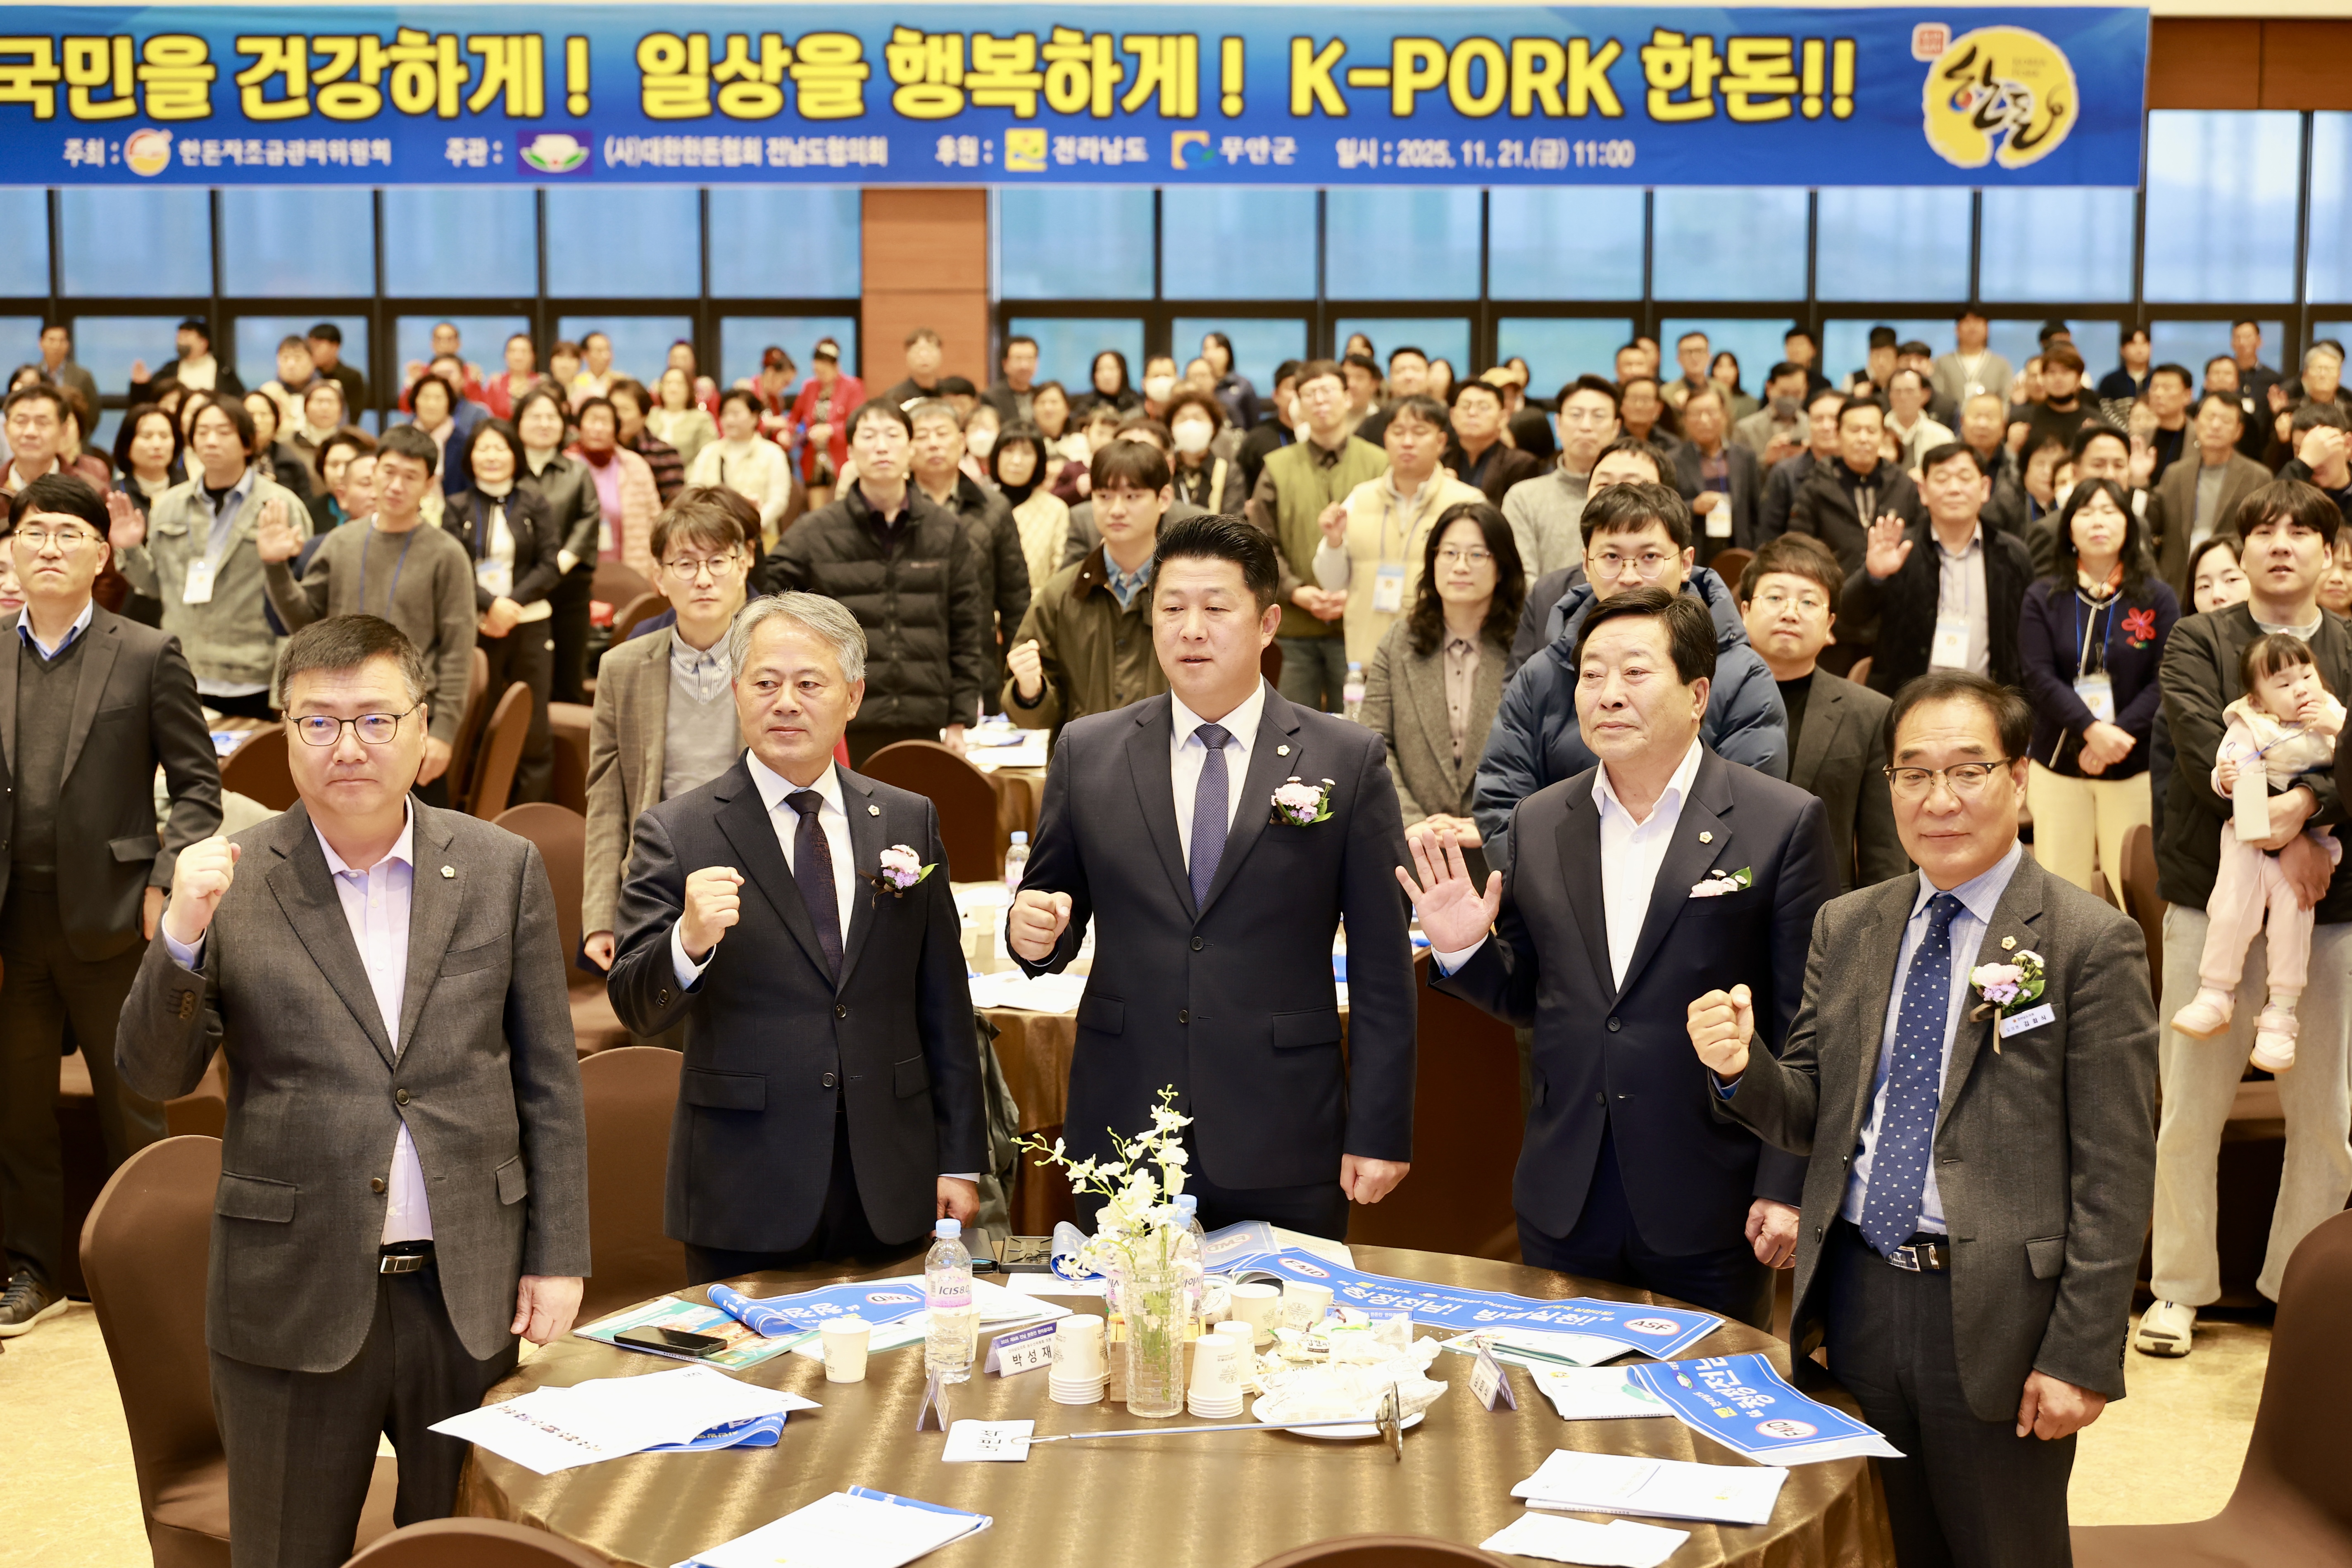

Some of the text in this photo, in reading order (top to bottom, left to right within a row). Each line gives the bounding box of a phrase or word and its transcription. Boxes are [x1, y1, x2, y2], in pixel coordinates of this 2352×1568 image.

[0, 34, 216, 120] 국민을
[236, 27, 544, 120] 건강하게
[636, 31, 870, 119] 일상을
[885, 25, 1198, 119] 행복하게
[1290, 36, 1624, 117] K-PORK
[1641, 26, 1856, 121] 한돈!!
[939, 1286, 959, 1295] ICIS
[1630, 1320, 1673, 1331] ASF
[976, 1429, 1004, 1451] 내빈석
